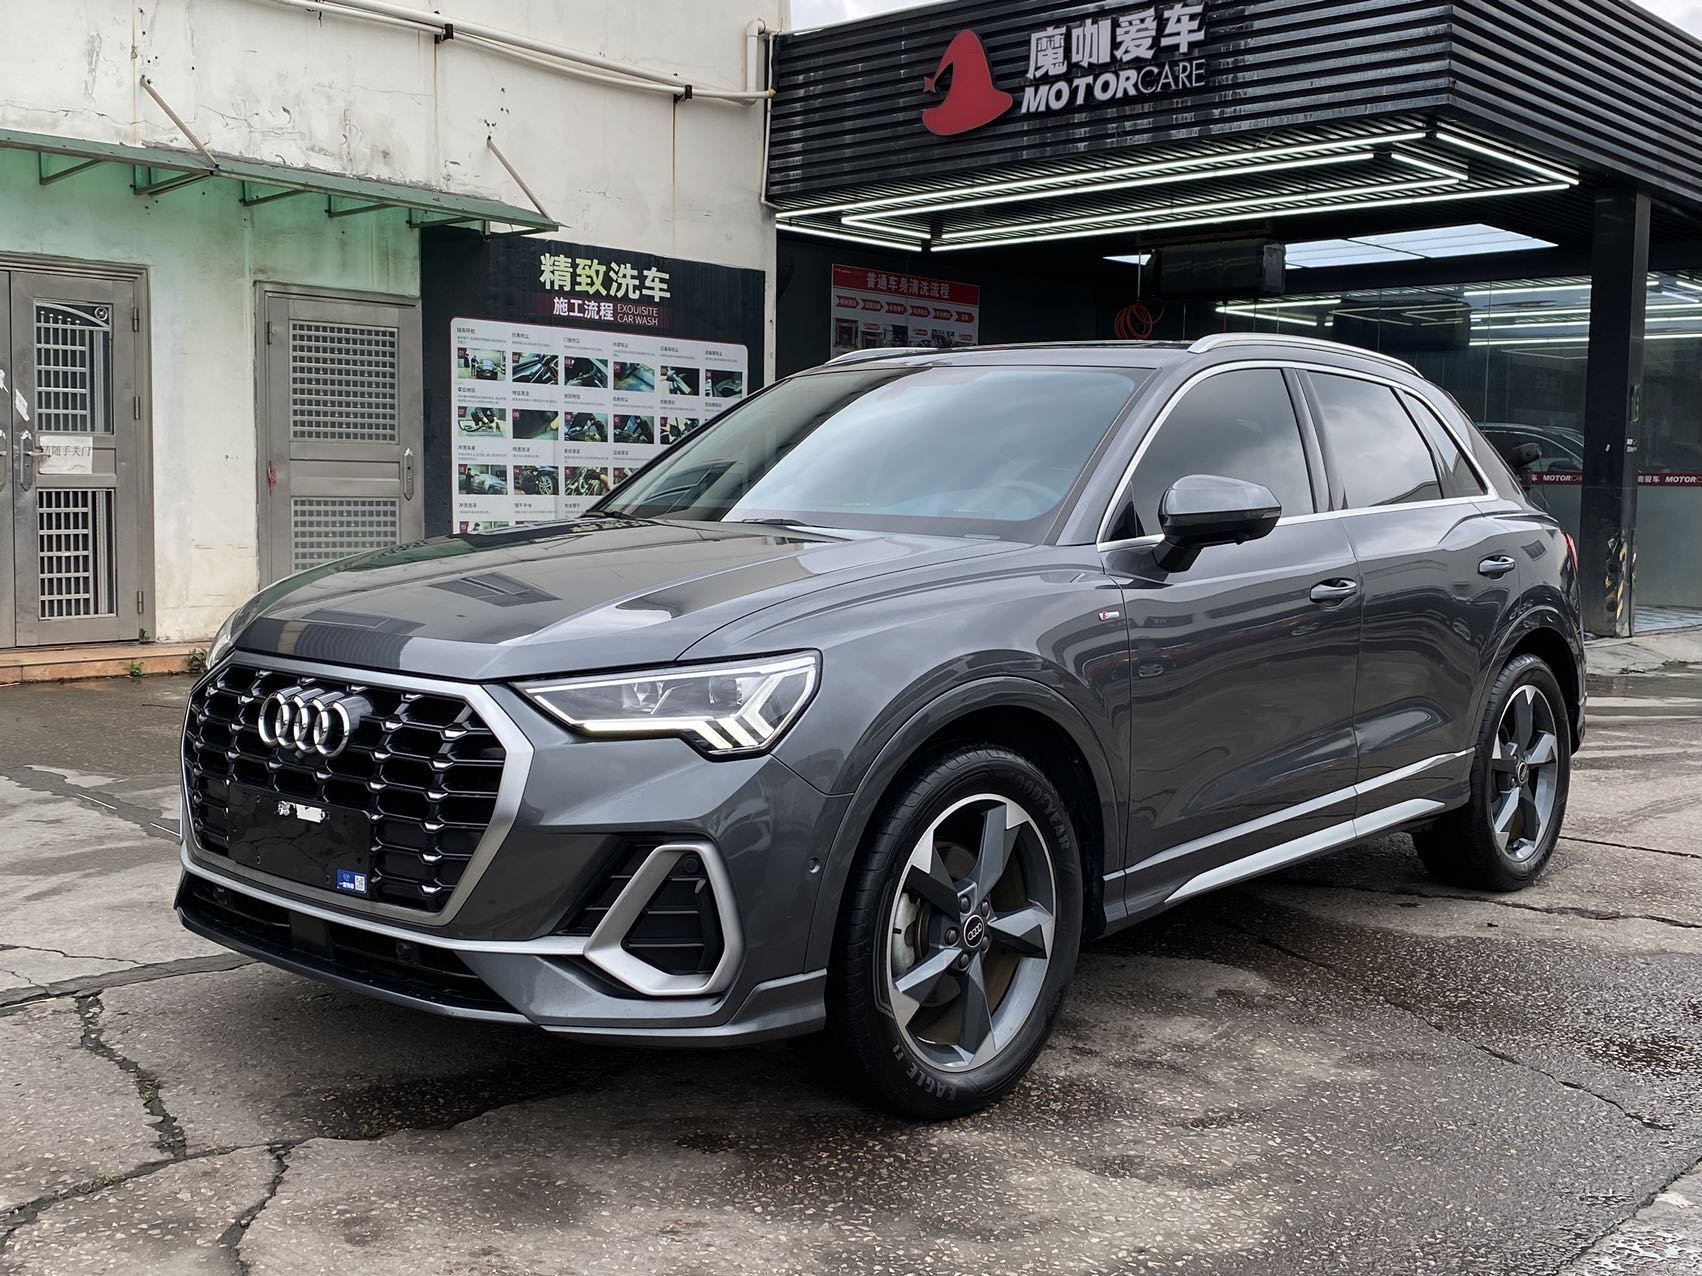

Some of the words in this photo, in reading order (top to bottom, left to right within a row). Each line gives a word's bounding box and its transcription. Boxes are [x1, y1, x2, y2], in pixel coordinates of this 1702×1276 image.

[1025, 3, 1206, 80] 魔咖爱车
[1021, 59, 1207, 114] MOTORCARE
[539, 253, 671, 302] 精致洗车
[866, 272, 951, 299] 普通车身清洗流程
[553, 296, 614, 321] 施工流程
[617, 313, 634, 324] CAR
[635, 316, 658, 326] WASH
